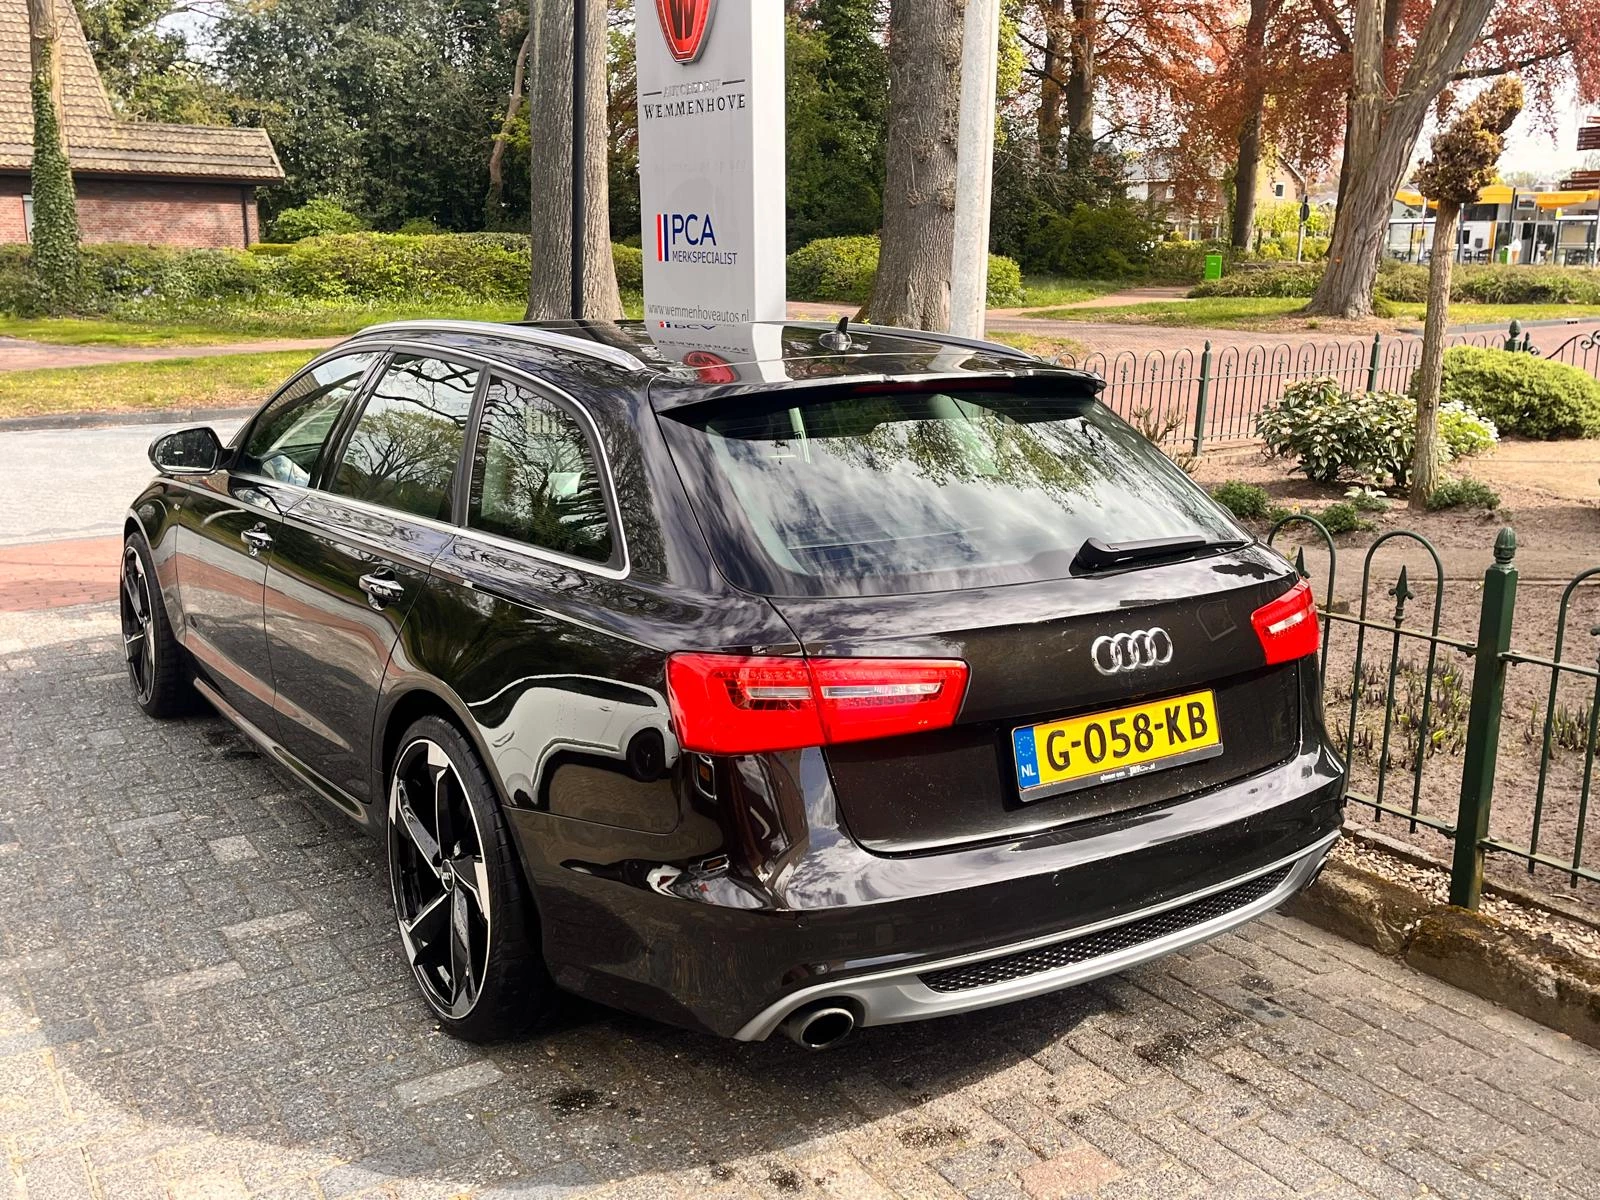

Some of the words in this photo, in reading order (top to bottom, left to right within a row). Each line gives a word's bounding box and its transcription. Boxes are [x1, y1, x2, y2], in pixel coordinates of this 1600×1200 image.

[643, 94, 746, 120] WEMMENHOVE
[672, 213, 717, 246] PCA
[672, 250, 738, 265] MERKSPECIALIST
[1046, 701, 1208, 772] G-058-KB
[1020, 764, 1037, 778] NL
